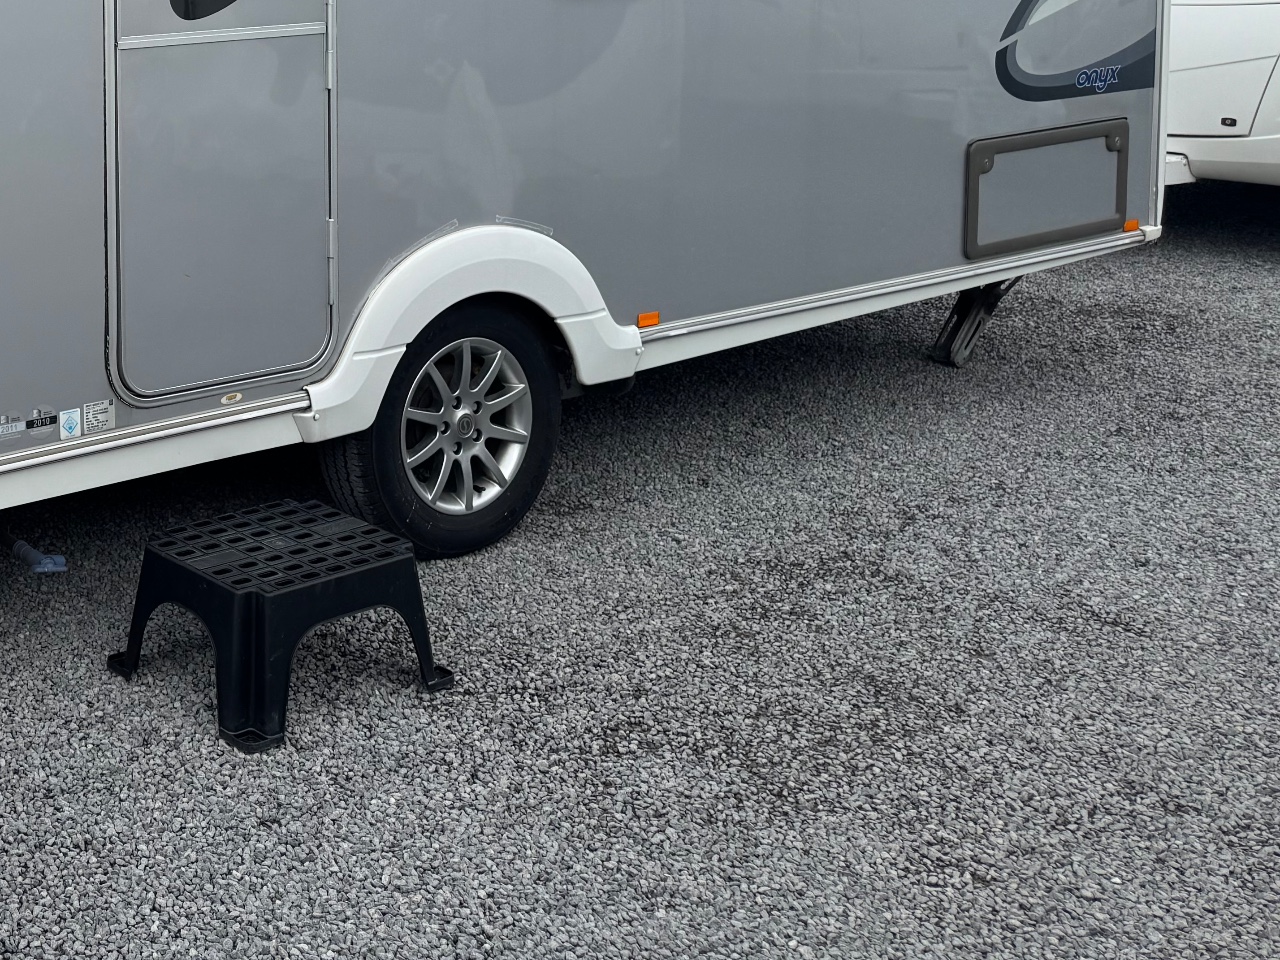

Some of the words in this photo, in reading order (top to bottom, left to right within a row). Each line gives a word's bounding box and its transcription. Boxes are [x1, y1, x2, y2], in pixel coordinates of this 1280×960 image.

[1075, 64, 1121, 93] onyx
[33, 417, 50, 428] 2010
[0, 424, 18, 434] 2011
